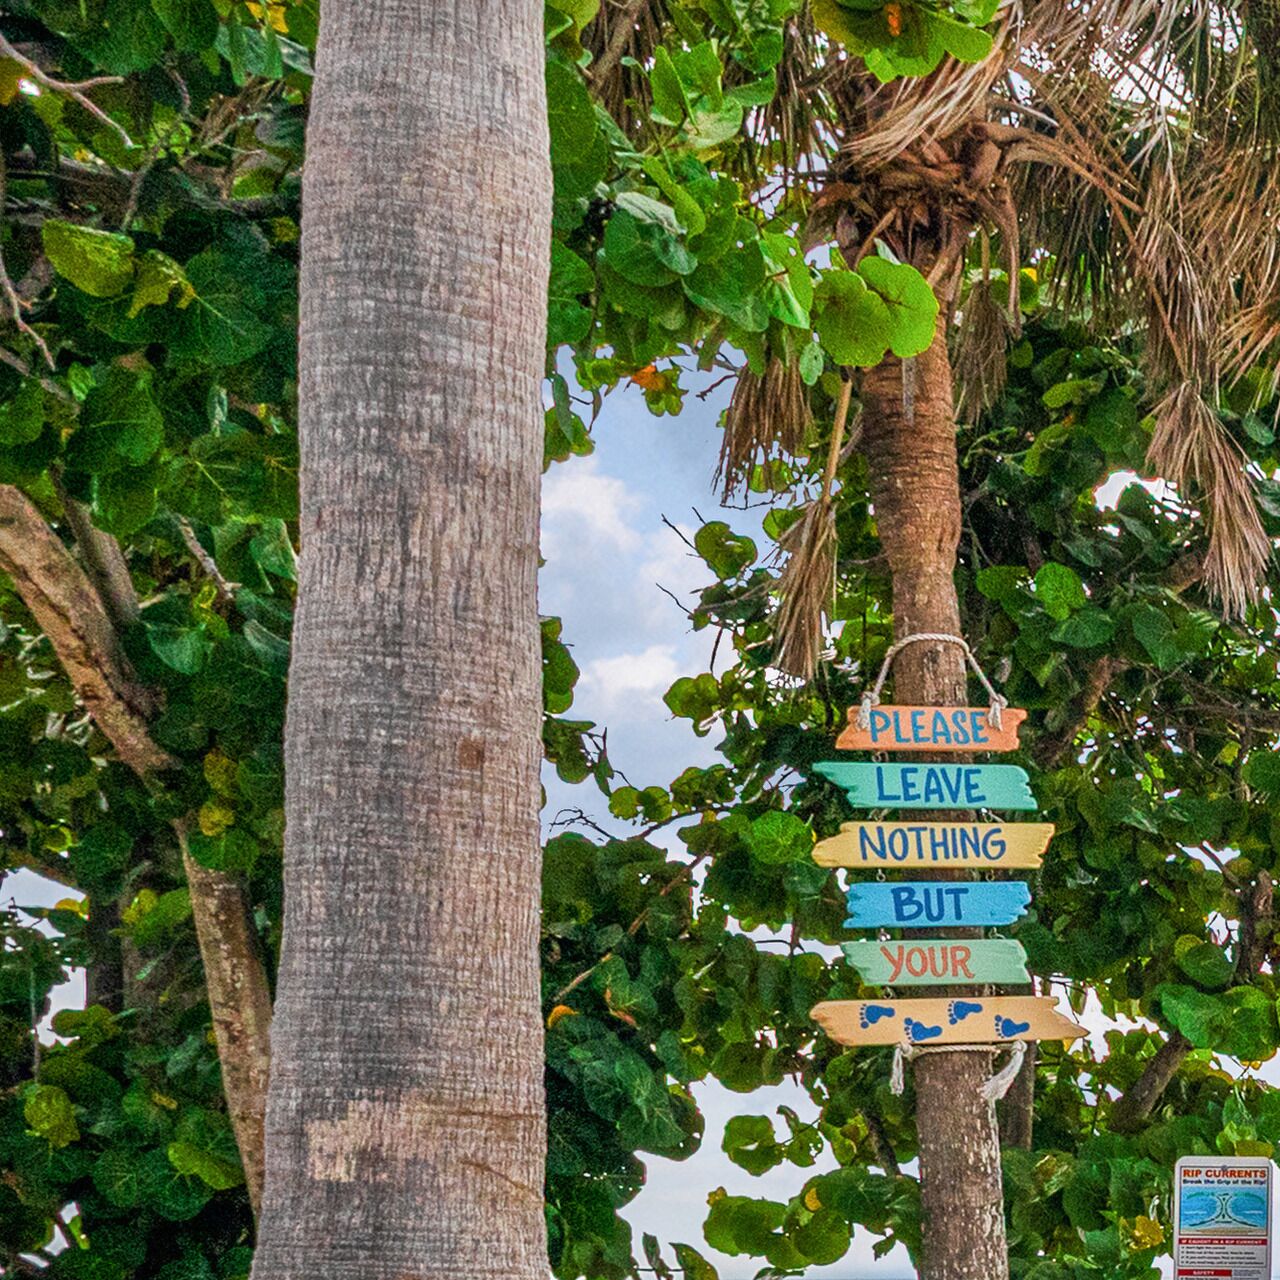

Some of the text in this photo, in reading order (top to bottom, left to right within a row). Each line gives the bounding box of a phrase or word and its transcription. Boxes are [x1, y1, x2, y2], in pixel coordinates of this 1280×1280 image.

[868, 710, 989, 744] PLEASE
[876, 767, 986, 804] LEAVE
[859, 826, 1006, 861] NOTHING
[891, 886, 969, 922] BUT
[880, 944, 975, 983] YOUR
[1183, 1169, 1266, 1178] RIP CURRENTS
